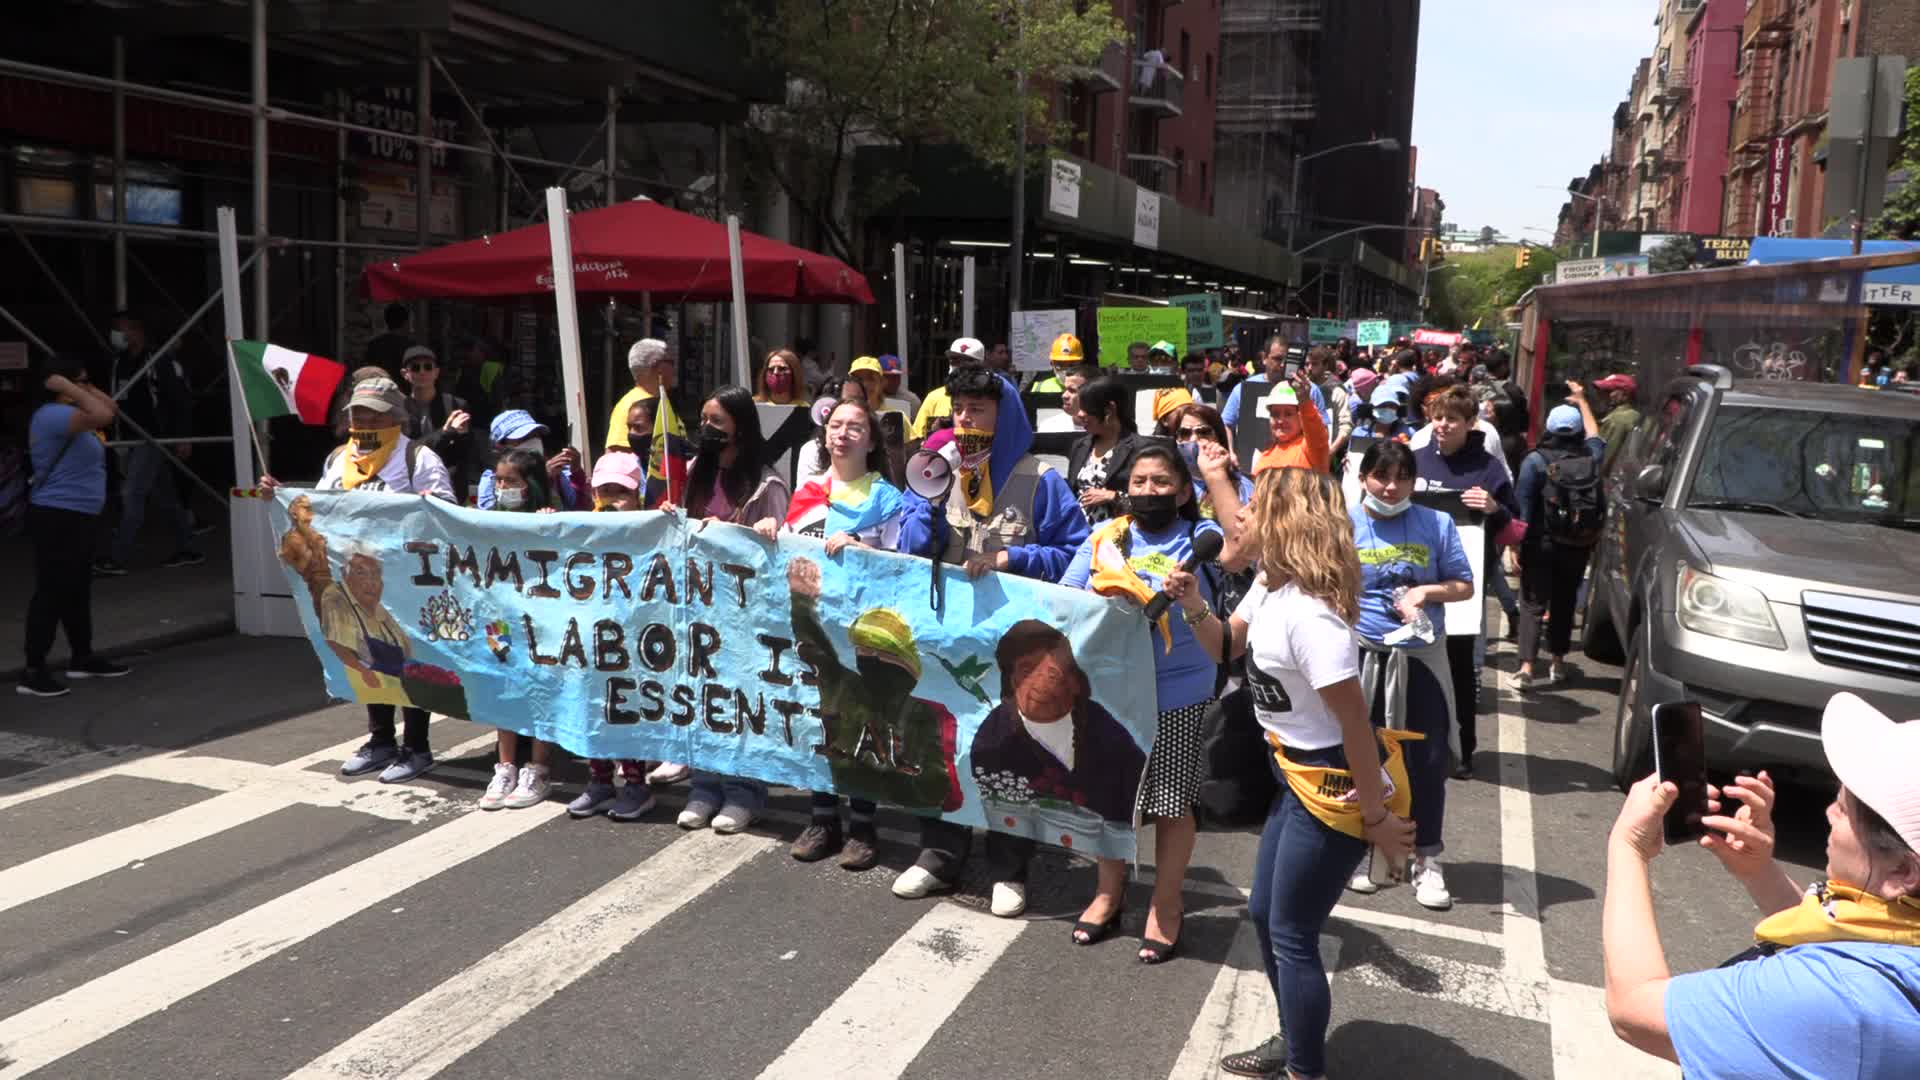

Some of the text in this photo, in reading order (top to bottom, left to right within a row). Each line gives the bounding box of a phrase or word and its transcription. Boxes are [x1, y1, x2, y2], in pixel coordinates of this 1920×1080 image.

[353, 101, 457, 140] STUDNT
[1768, 137, 1785, 238] THE RED LIO
[1563, 264, 1600, 273] FROZEN
[1702, 239, 1750, 249] TERRA
[1863, 285, 1912, 302] ITTER
[403, 541, 758, 608] IMMIGRANT
[522, 614, 821, 688] LABOR IS
[605, 677, 922, 776] ESSENTIAL
